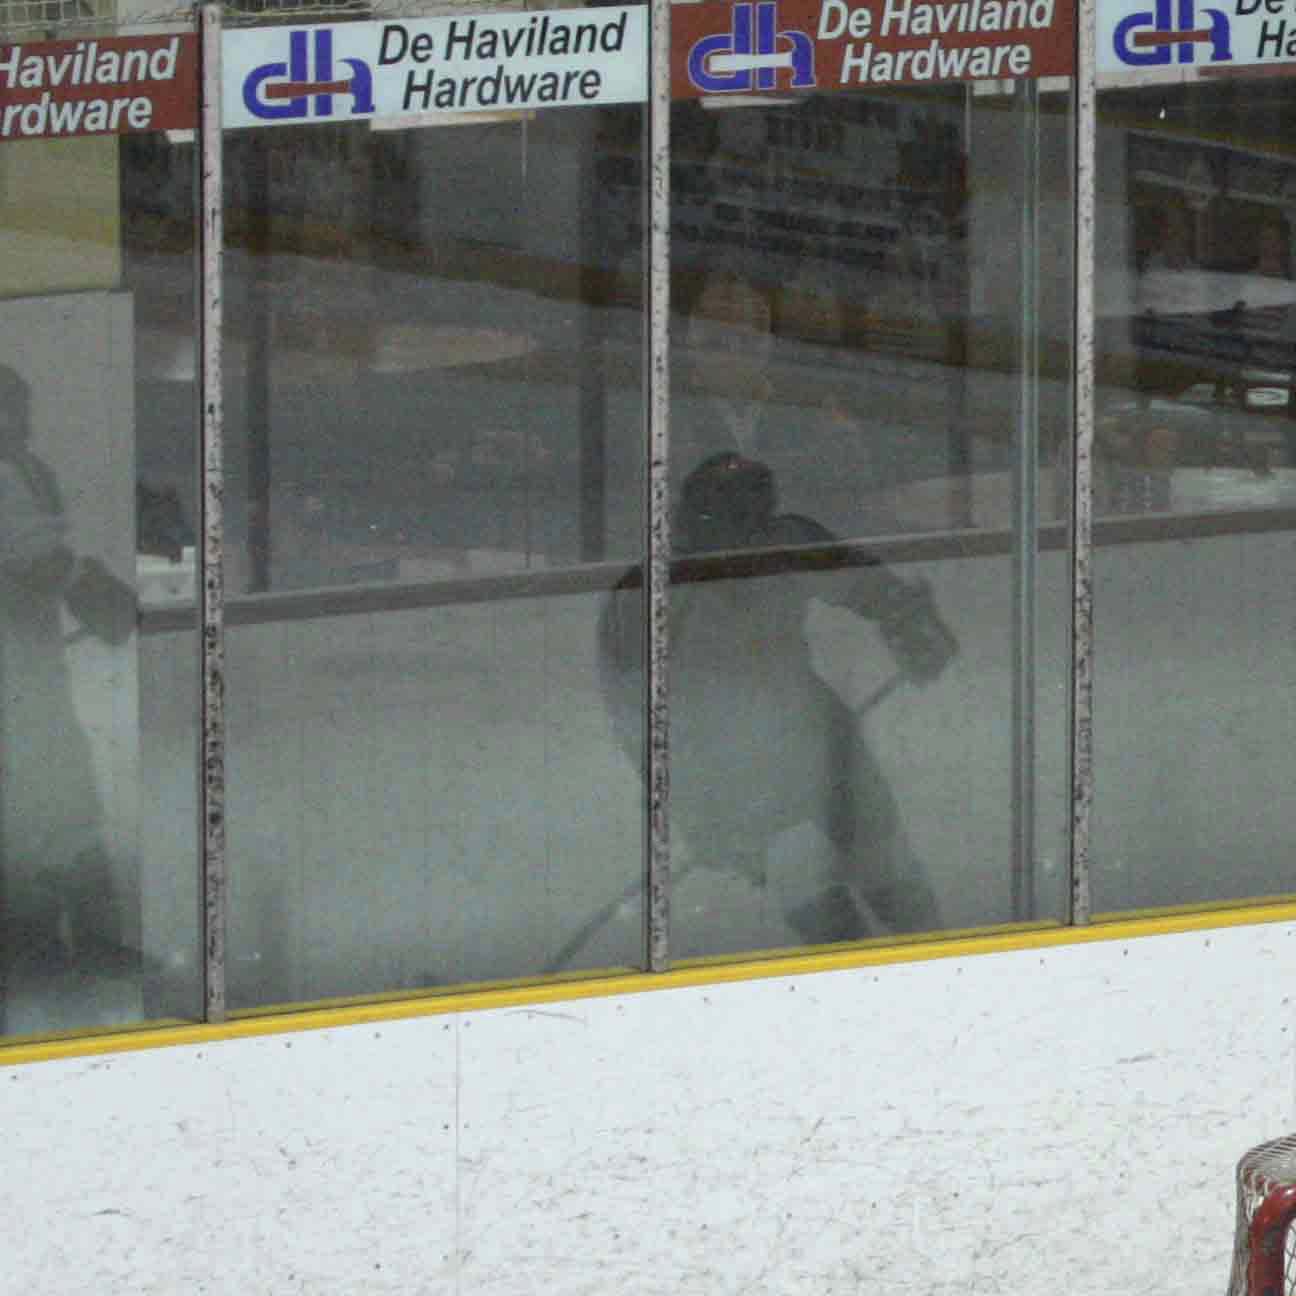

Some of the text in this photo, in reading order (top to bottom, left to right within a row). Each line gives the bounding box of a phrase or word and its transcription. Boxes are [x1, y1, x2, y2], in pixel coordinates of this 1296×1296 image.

[379, 12, 628, 65] De Haviland
[817, 0, 1056, 40] De Haviland
[840, 39, 1031, 84] Hardware
[403, 65, 602, 111] Hardware
[0, 92, 153, 137] rdware
